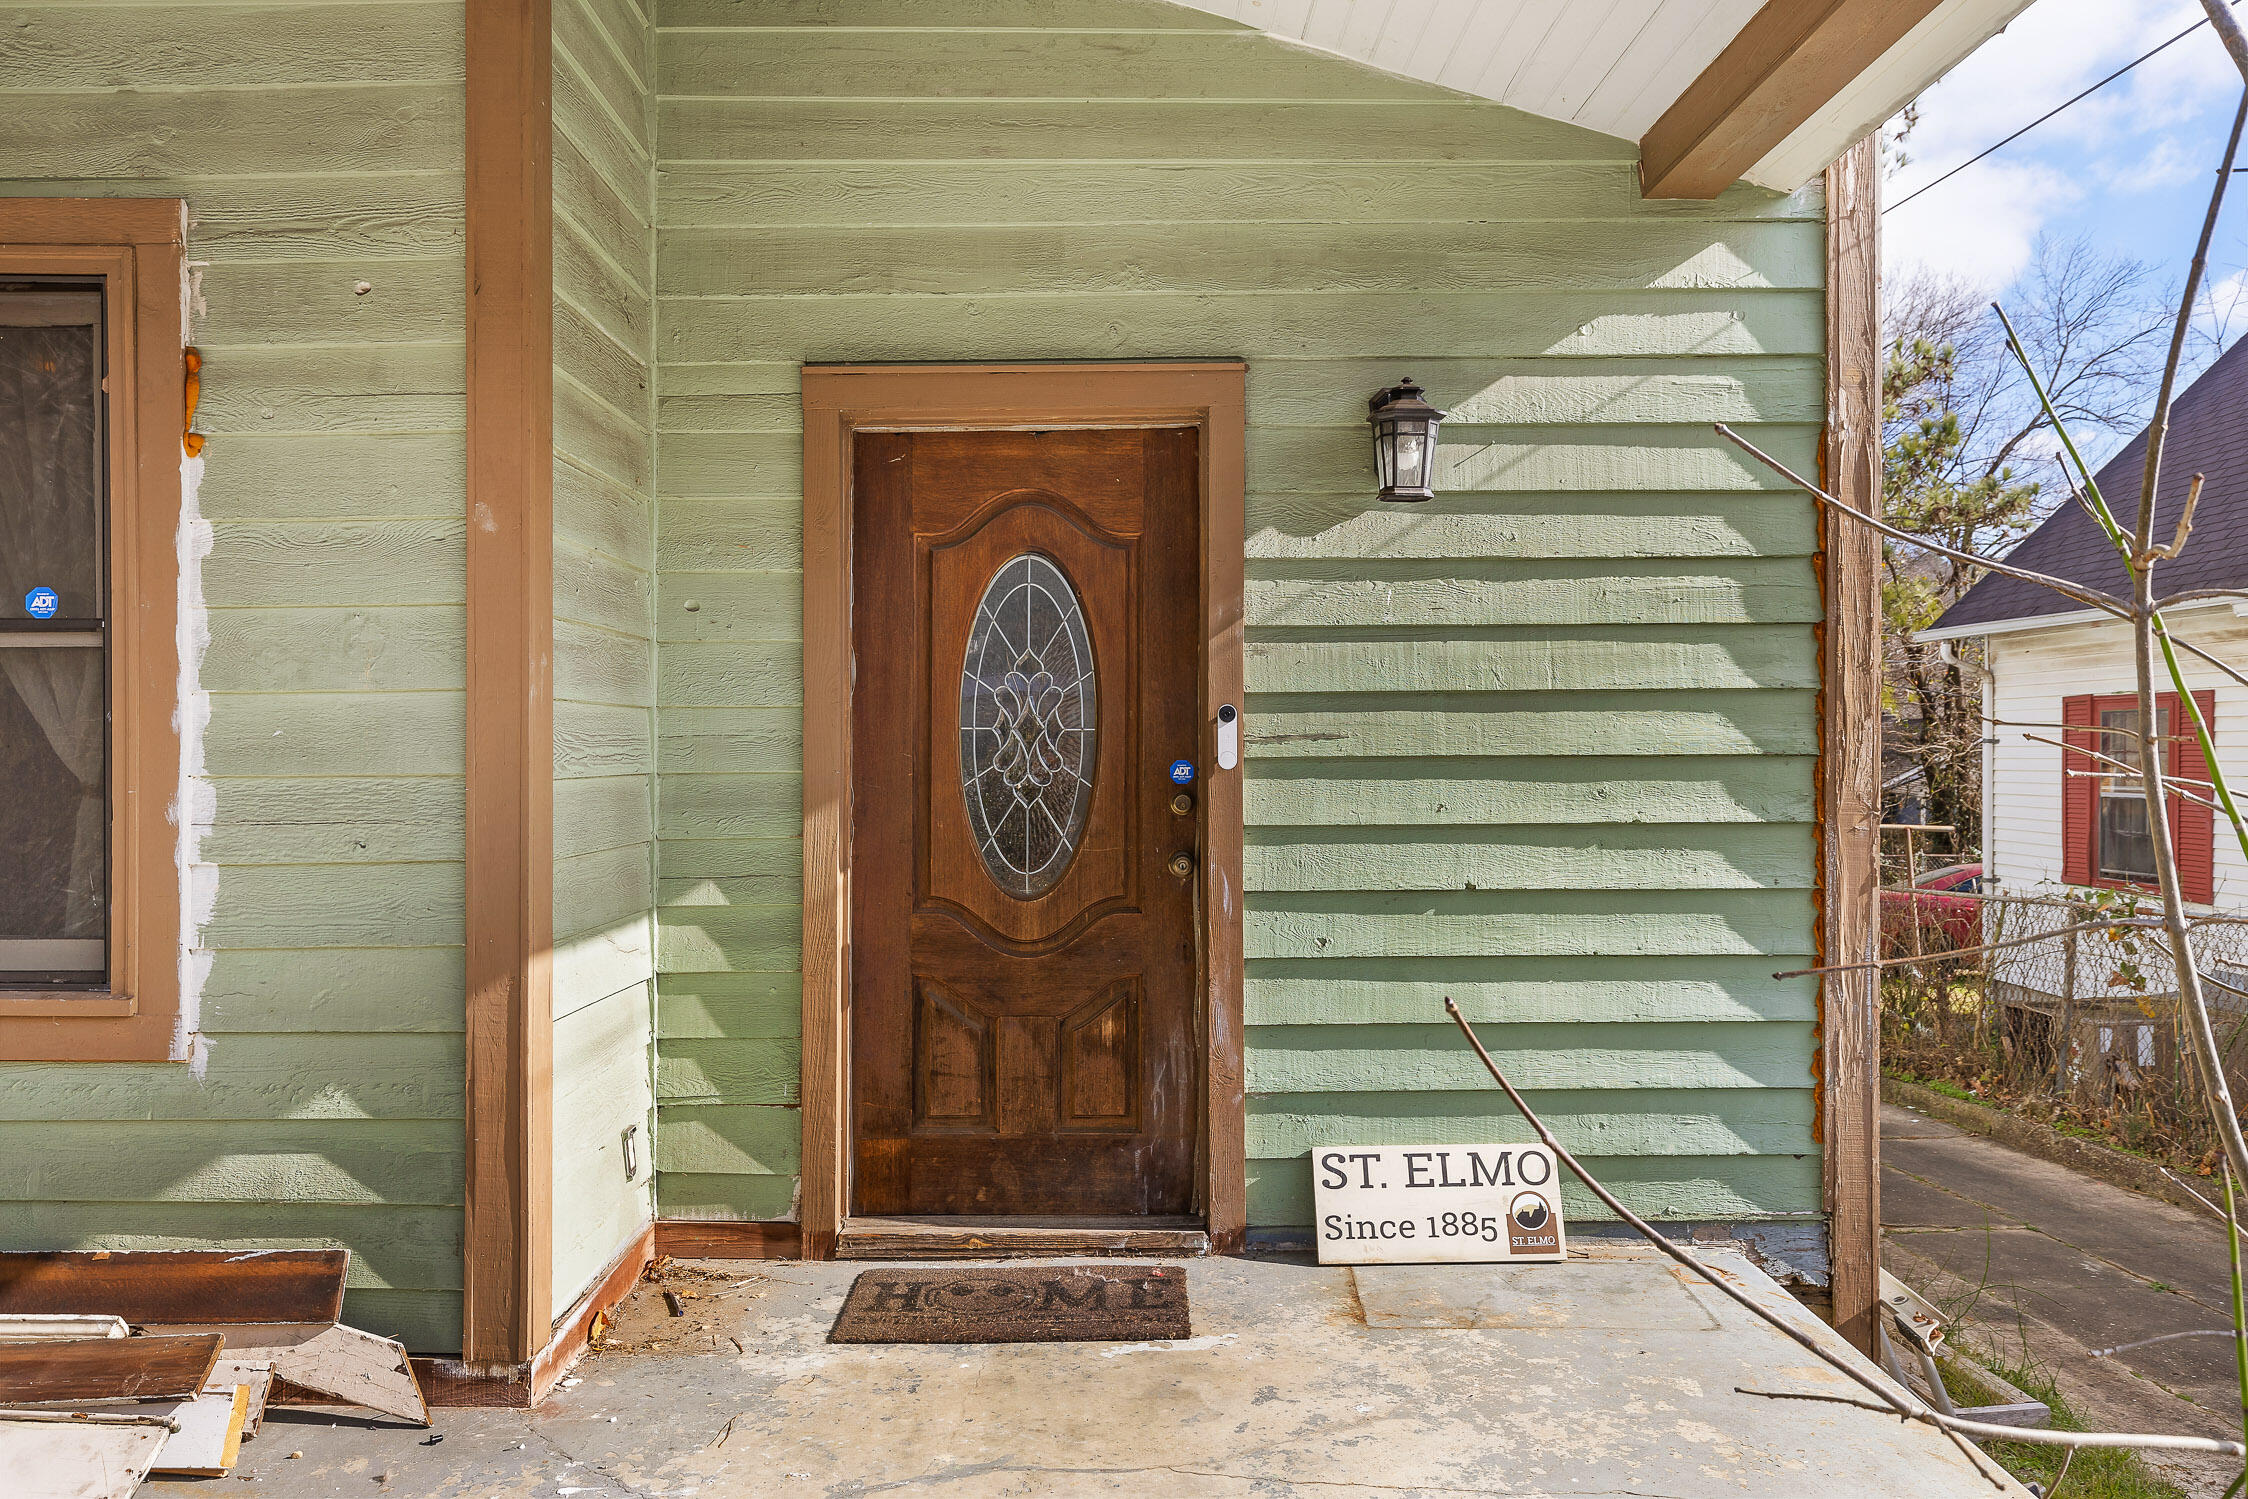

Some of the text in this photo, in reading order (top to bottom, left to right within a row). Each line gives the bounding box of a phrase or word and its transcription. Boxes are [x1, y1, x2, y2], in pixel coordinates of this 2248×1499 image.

[31, 596, 55, 608] ADT
[1173, 766, 1191, 775] ADT
[1321, 1151, 1551, 1190] ST. ELMO
[1324, 1212, 1498, 1242] Since 1885
[1512, 1235, 1556, 1246] ST. ELMO
